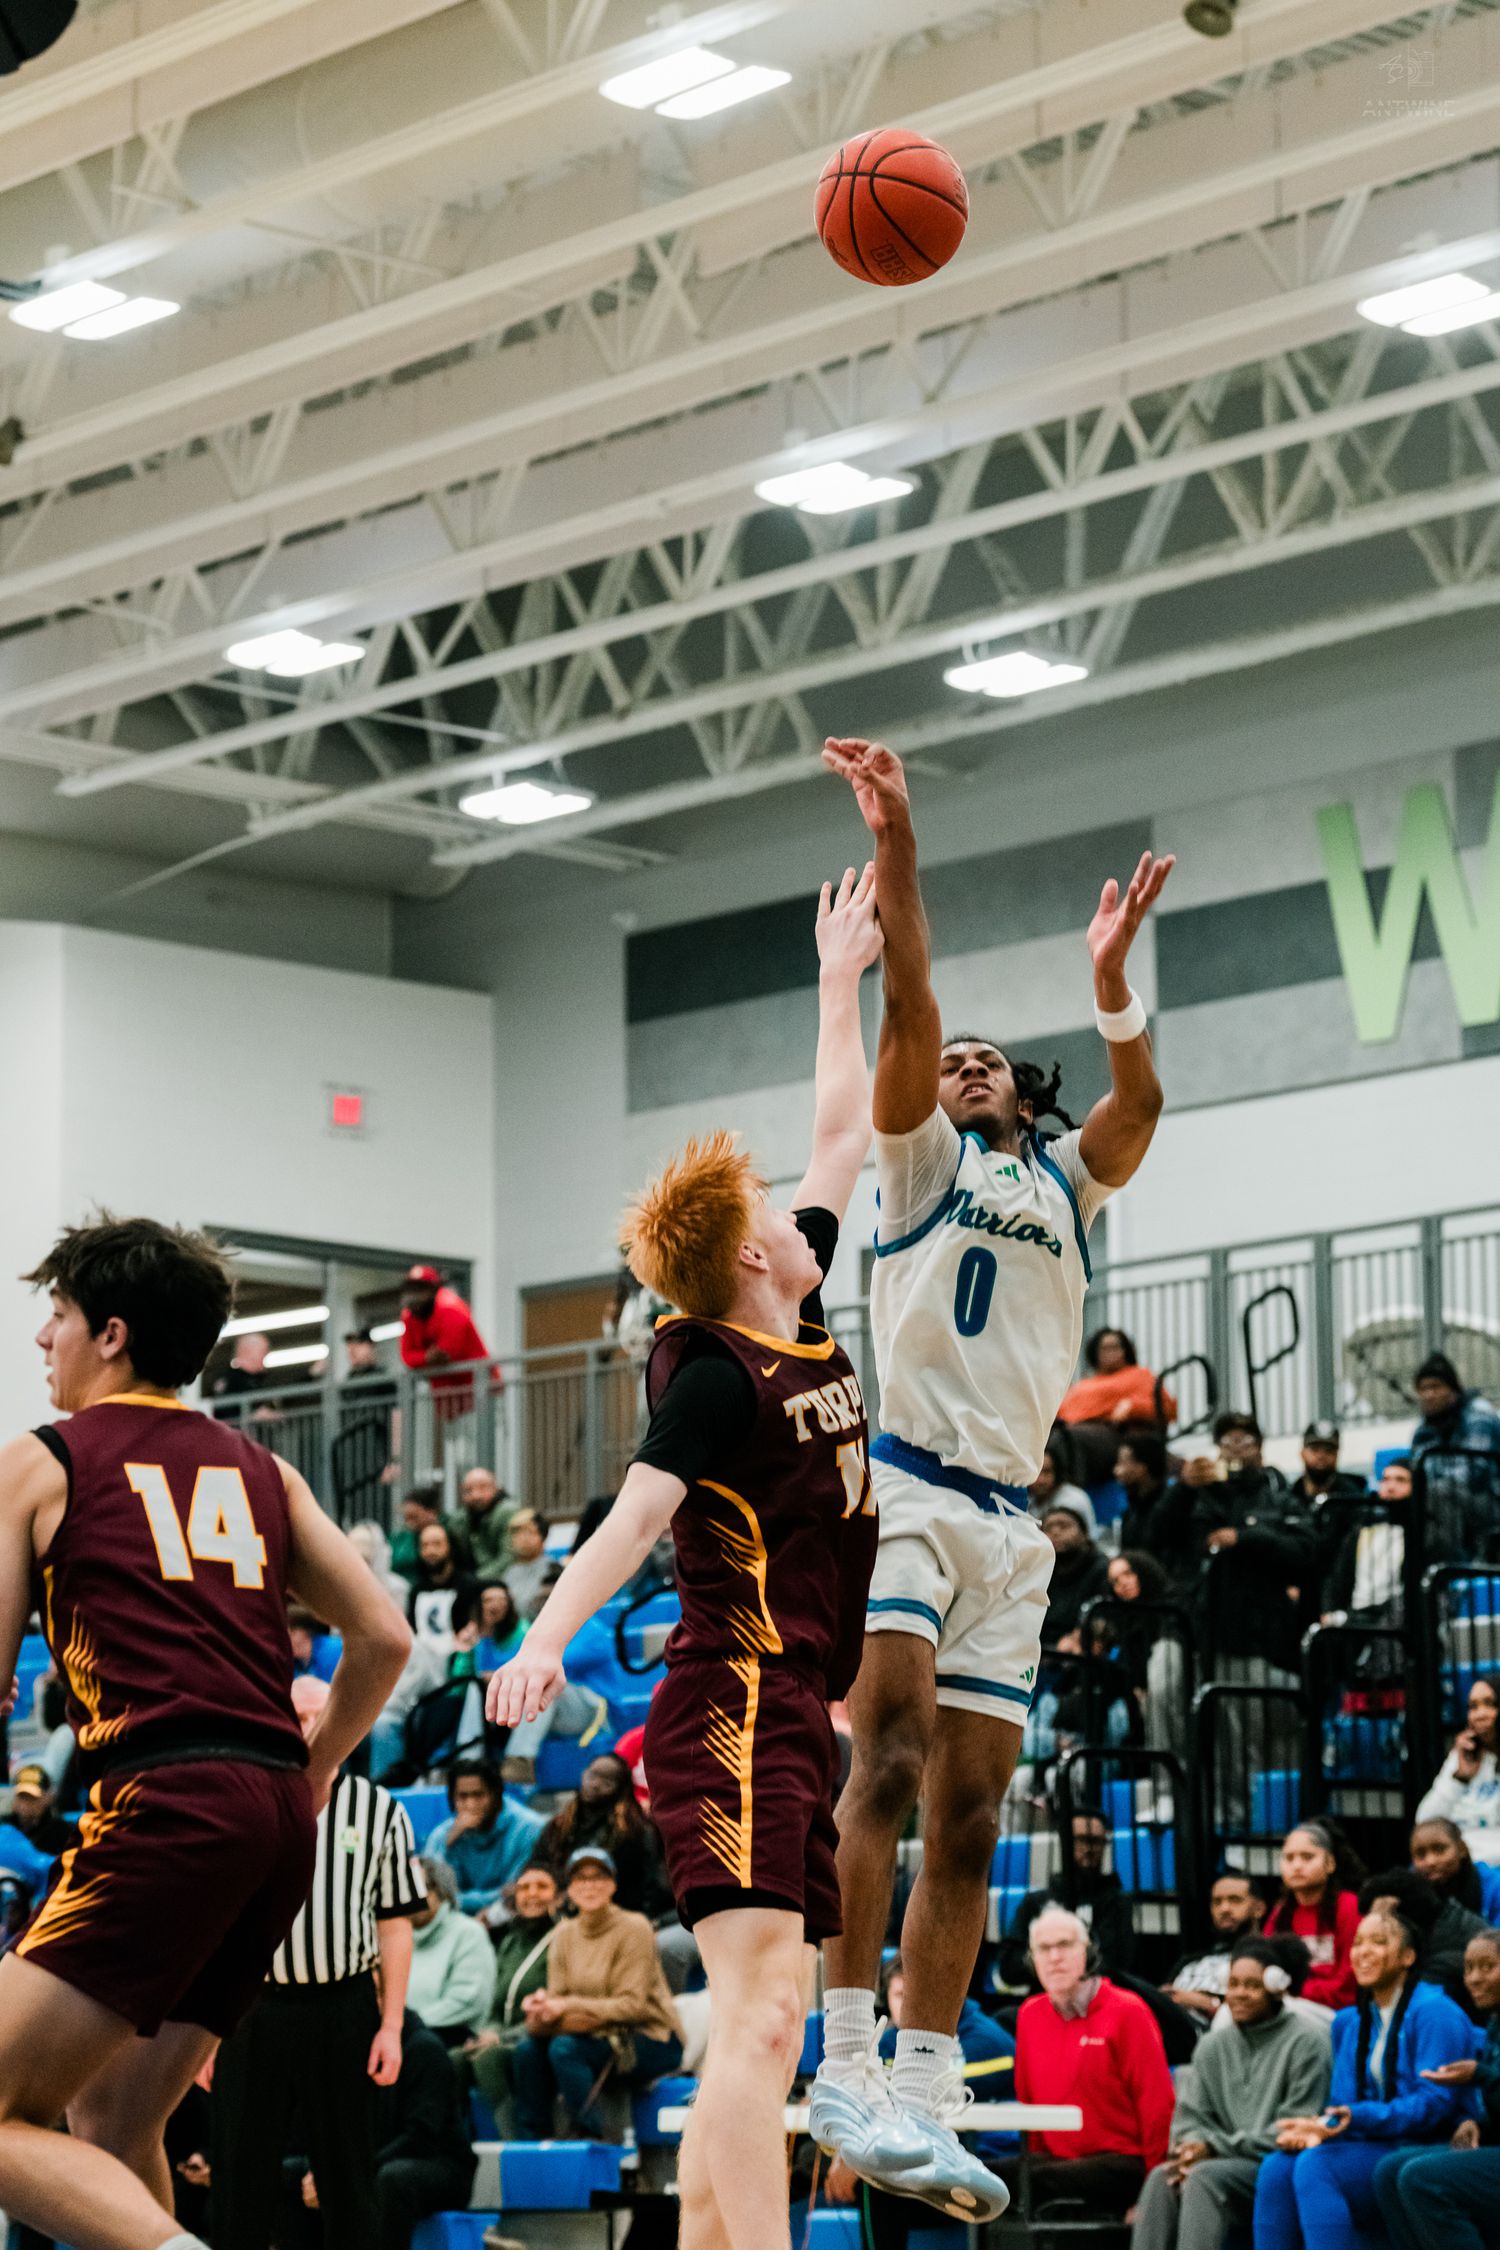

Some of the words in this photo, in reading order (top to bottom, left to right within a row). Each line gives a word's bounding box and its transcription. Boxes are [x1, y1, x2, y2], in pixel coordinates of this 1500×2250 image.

[1314, 765, 1500, 1041] W
[954, 1246, 998, 1335] 0
[783, 1374, 868, 1443] TURP
[124, 1462, 267, 1589] 14
